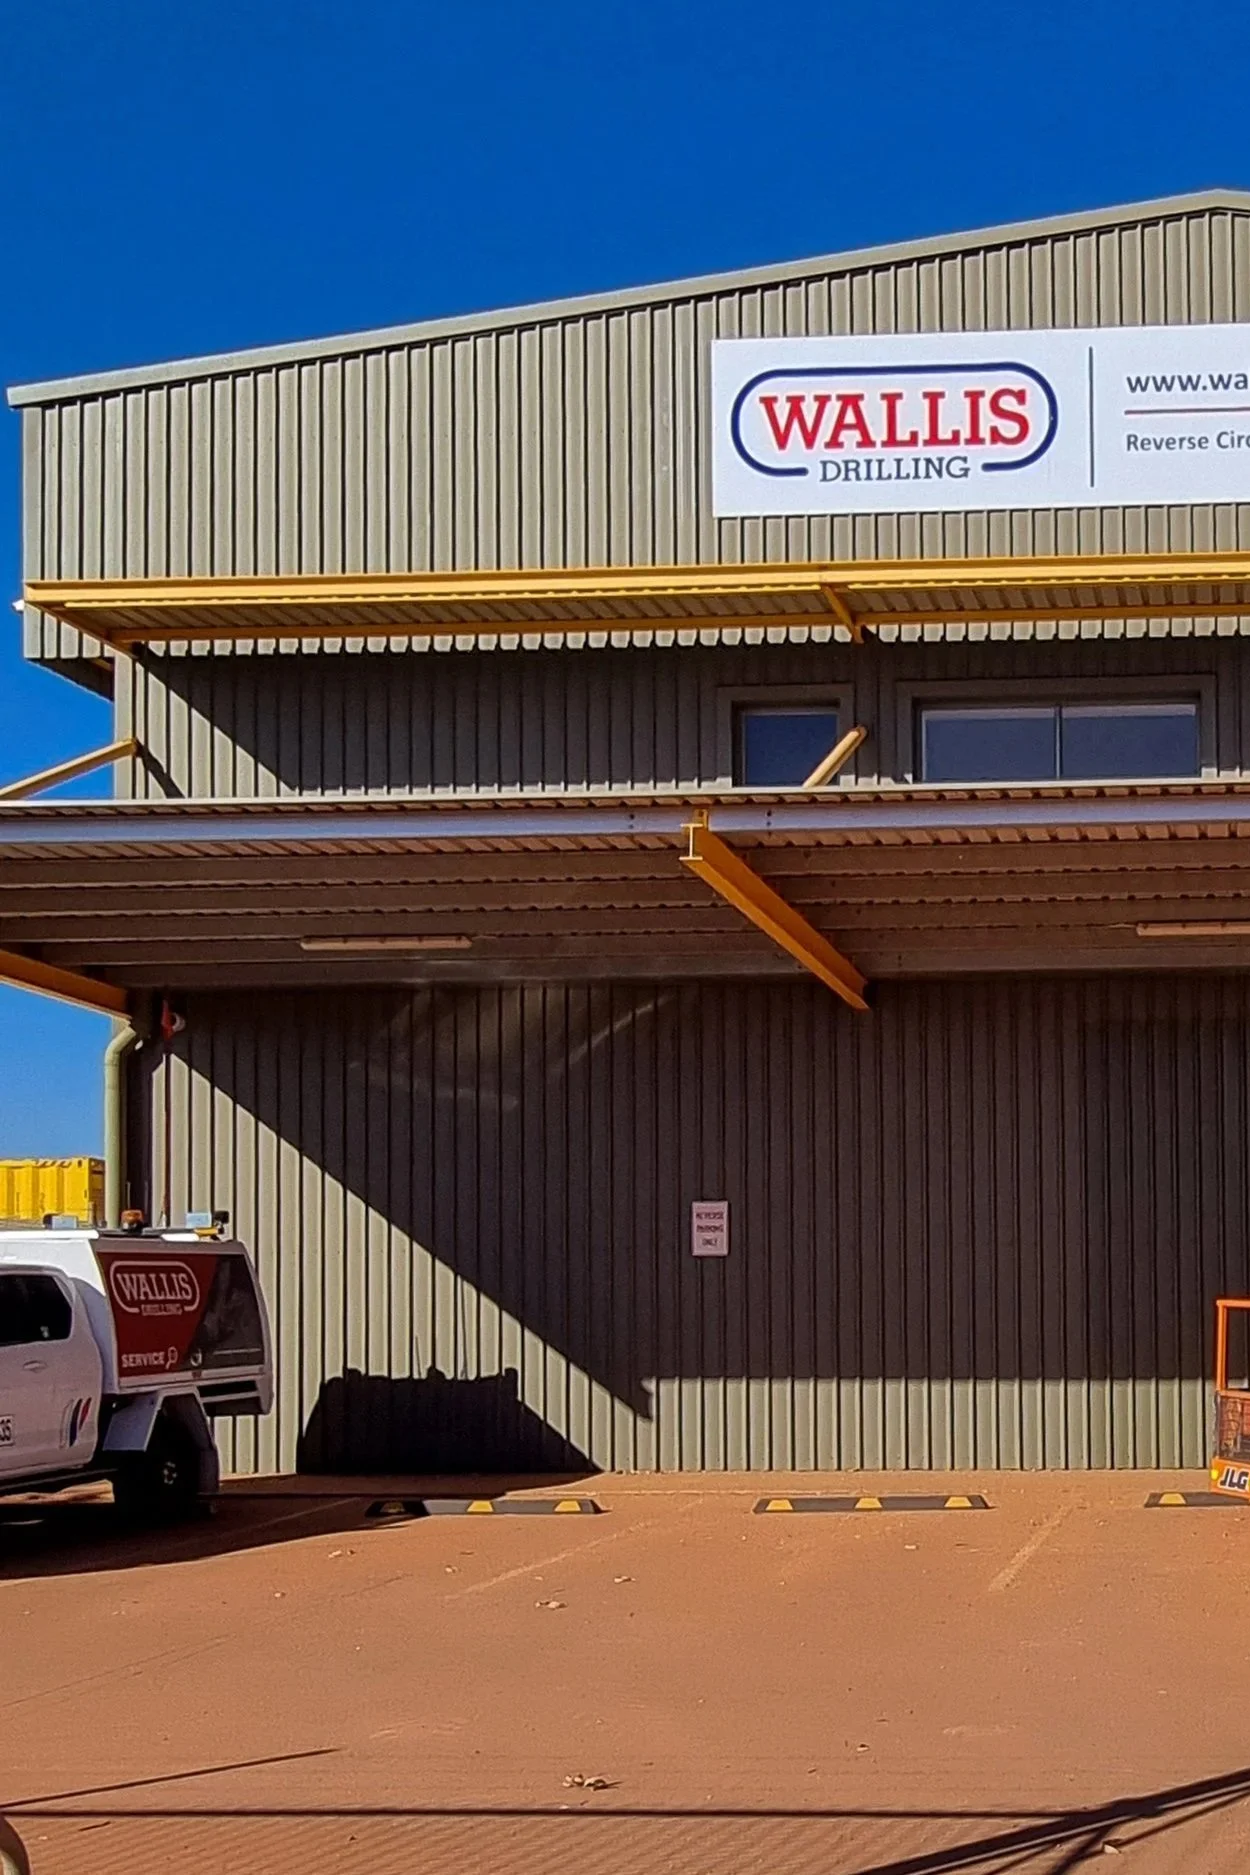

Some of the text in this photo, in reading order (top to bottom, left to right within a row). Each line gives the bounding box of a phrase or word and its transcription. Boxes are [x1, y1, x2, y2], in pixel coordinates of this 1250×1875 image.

[758, 387, 1031, 451] WALLIS
[1126, 433, 1209, 452] Reverse
[819, 455, 971, 483] DRILLING
[116, 1273, 192, 1300] WALLIS
[121, 1352, 165, 1368] SERVICE
[1219, 1467, 1250, 1490] JLG
